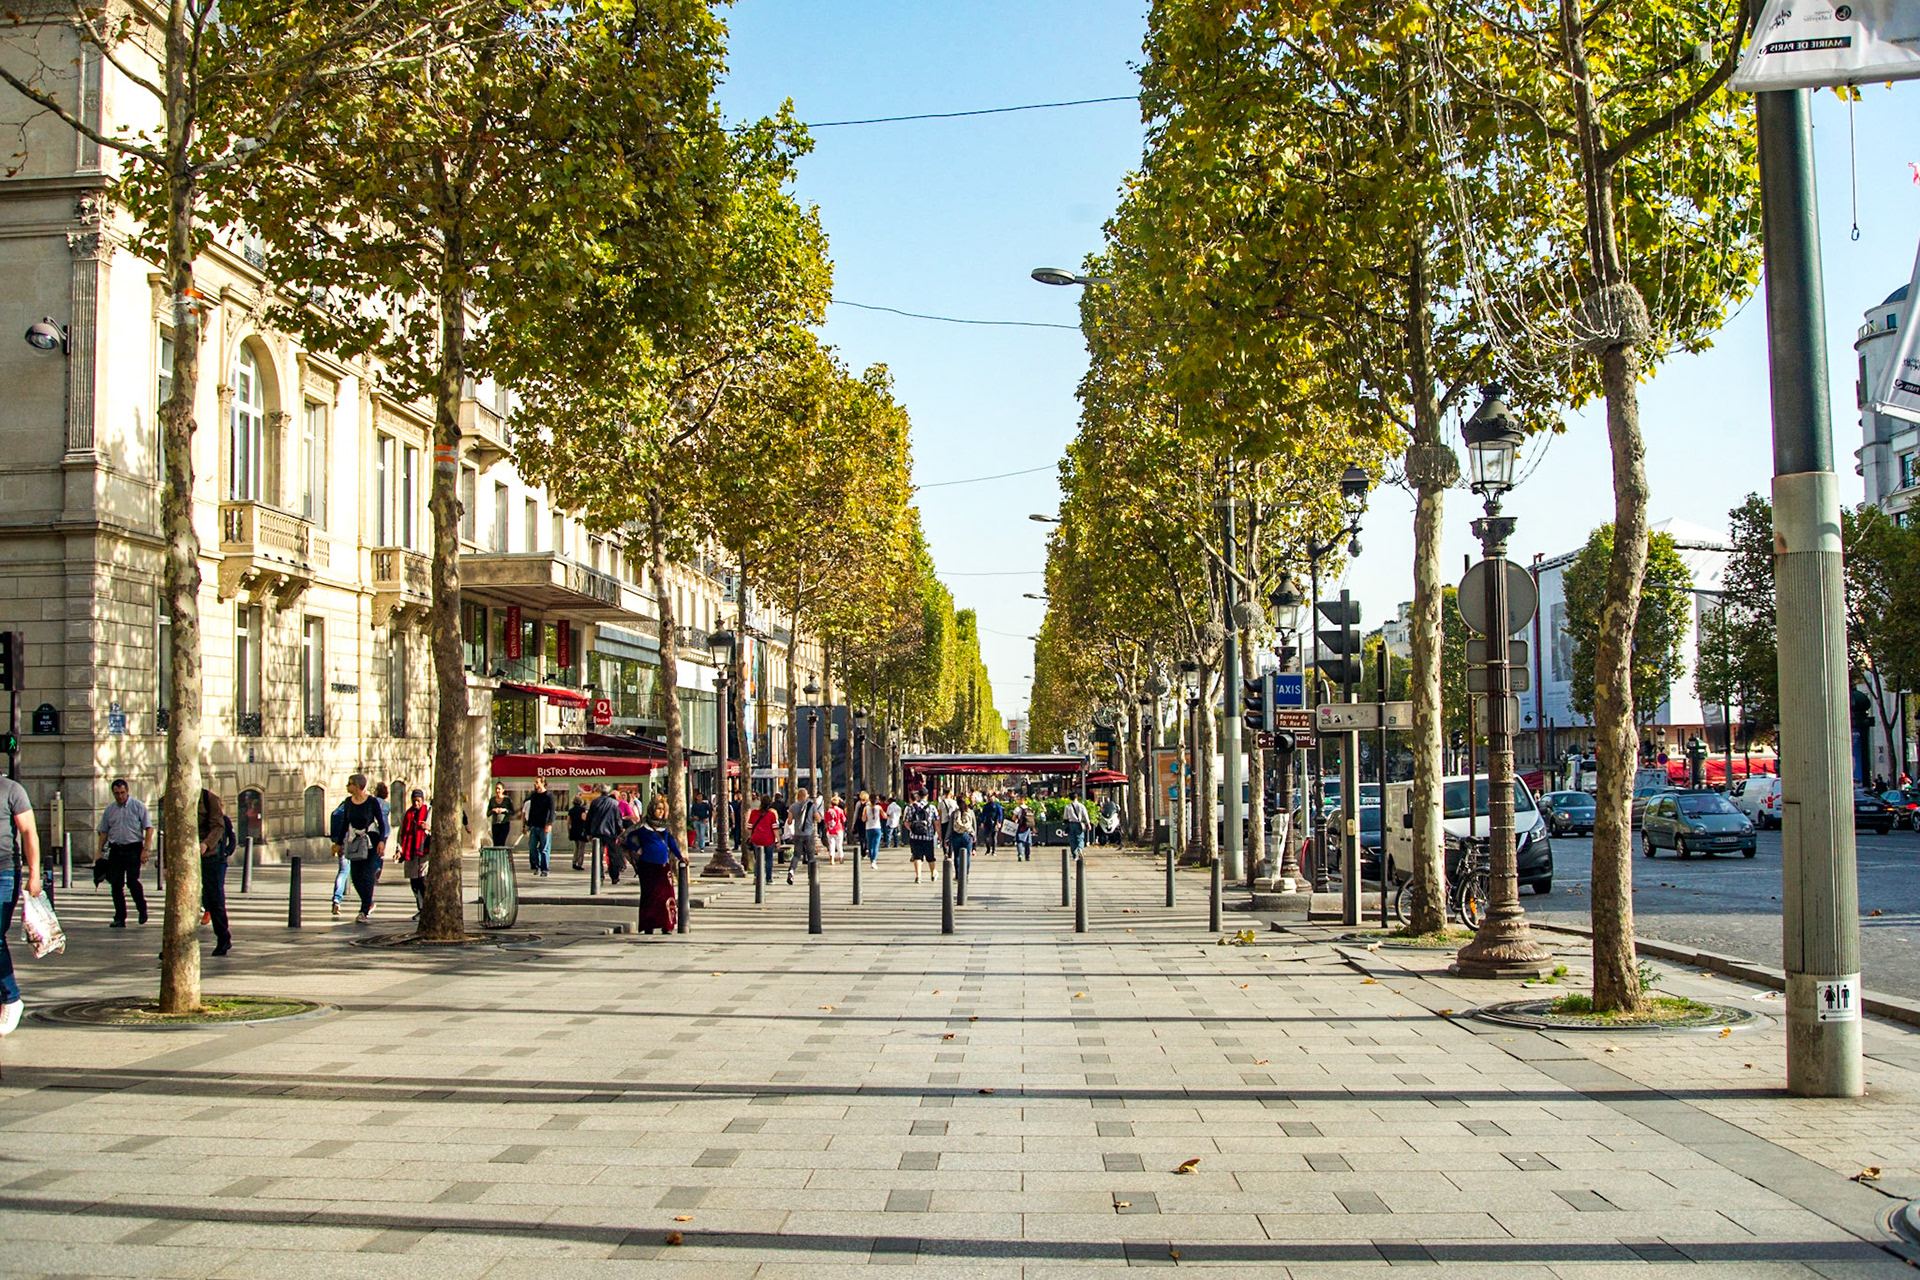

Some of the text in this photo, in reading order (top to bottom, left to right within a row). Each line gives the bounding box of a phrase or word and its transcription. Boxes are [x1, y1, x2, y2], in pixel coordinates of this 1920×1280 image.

[597, 701, 609, 715] Q
[537, 767, 606, 776] BISTRO ROMAIN
